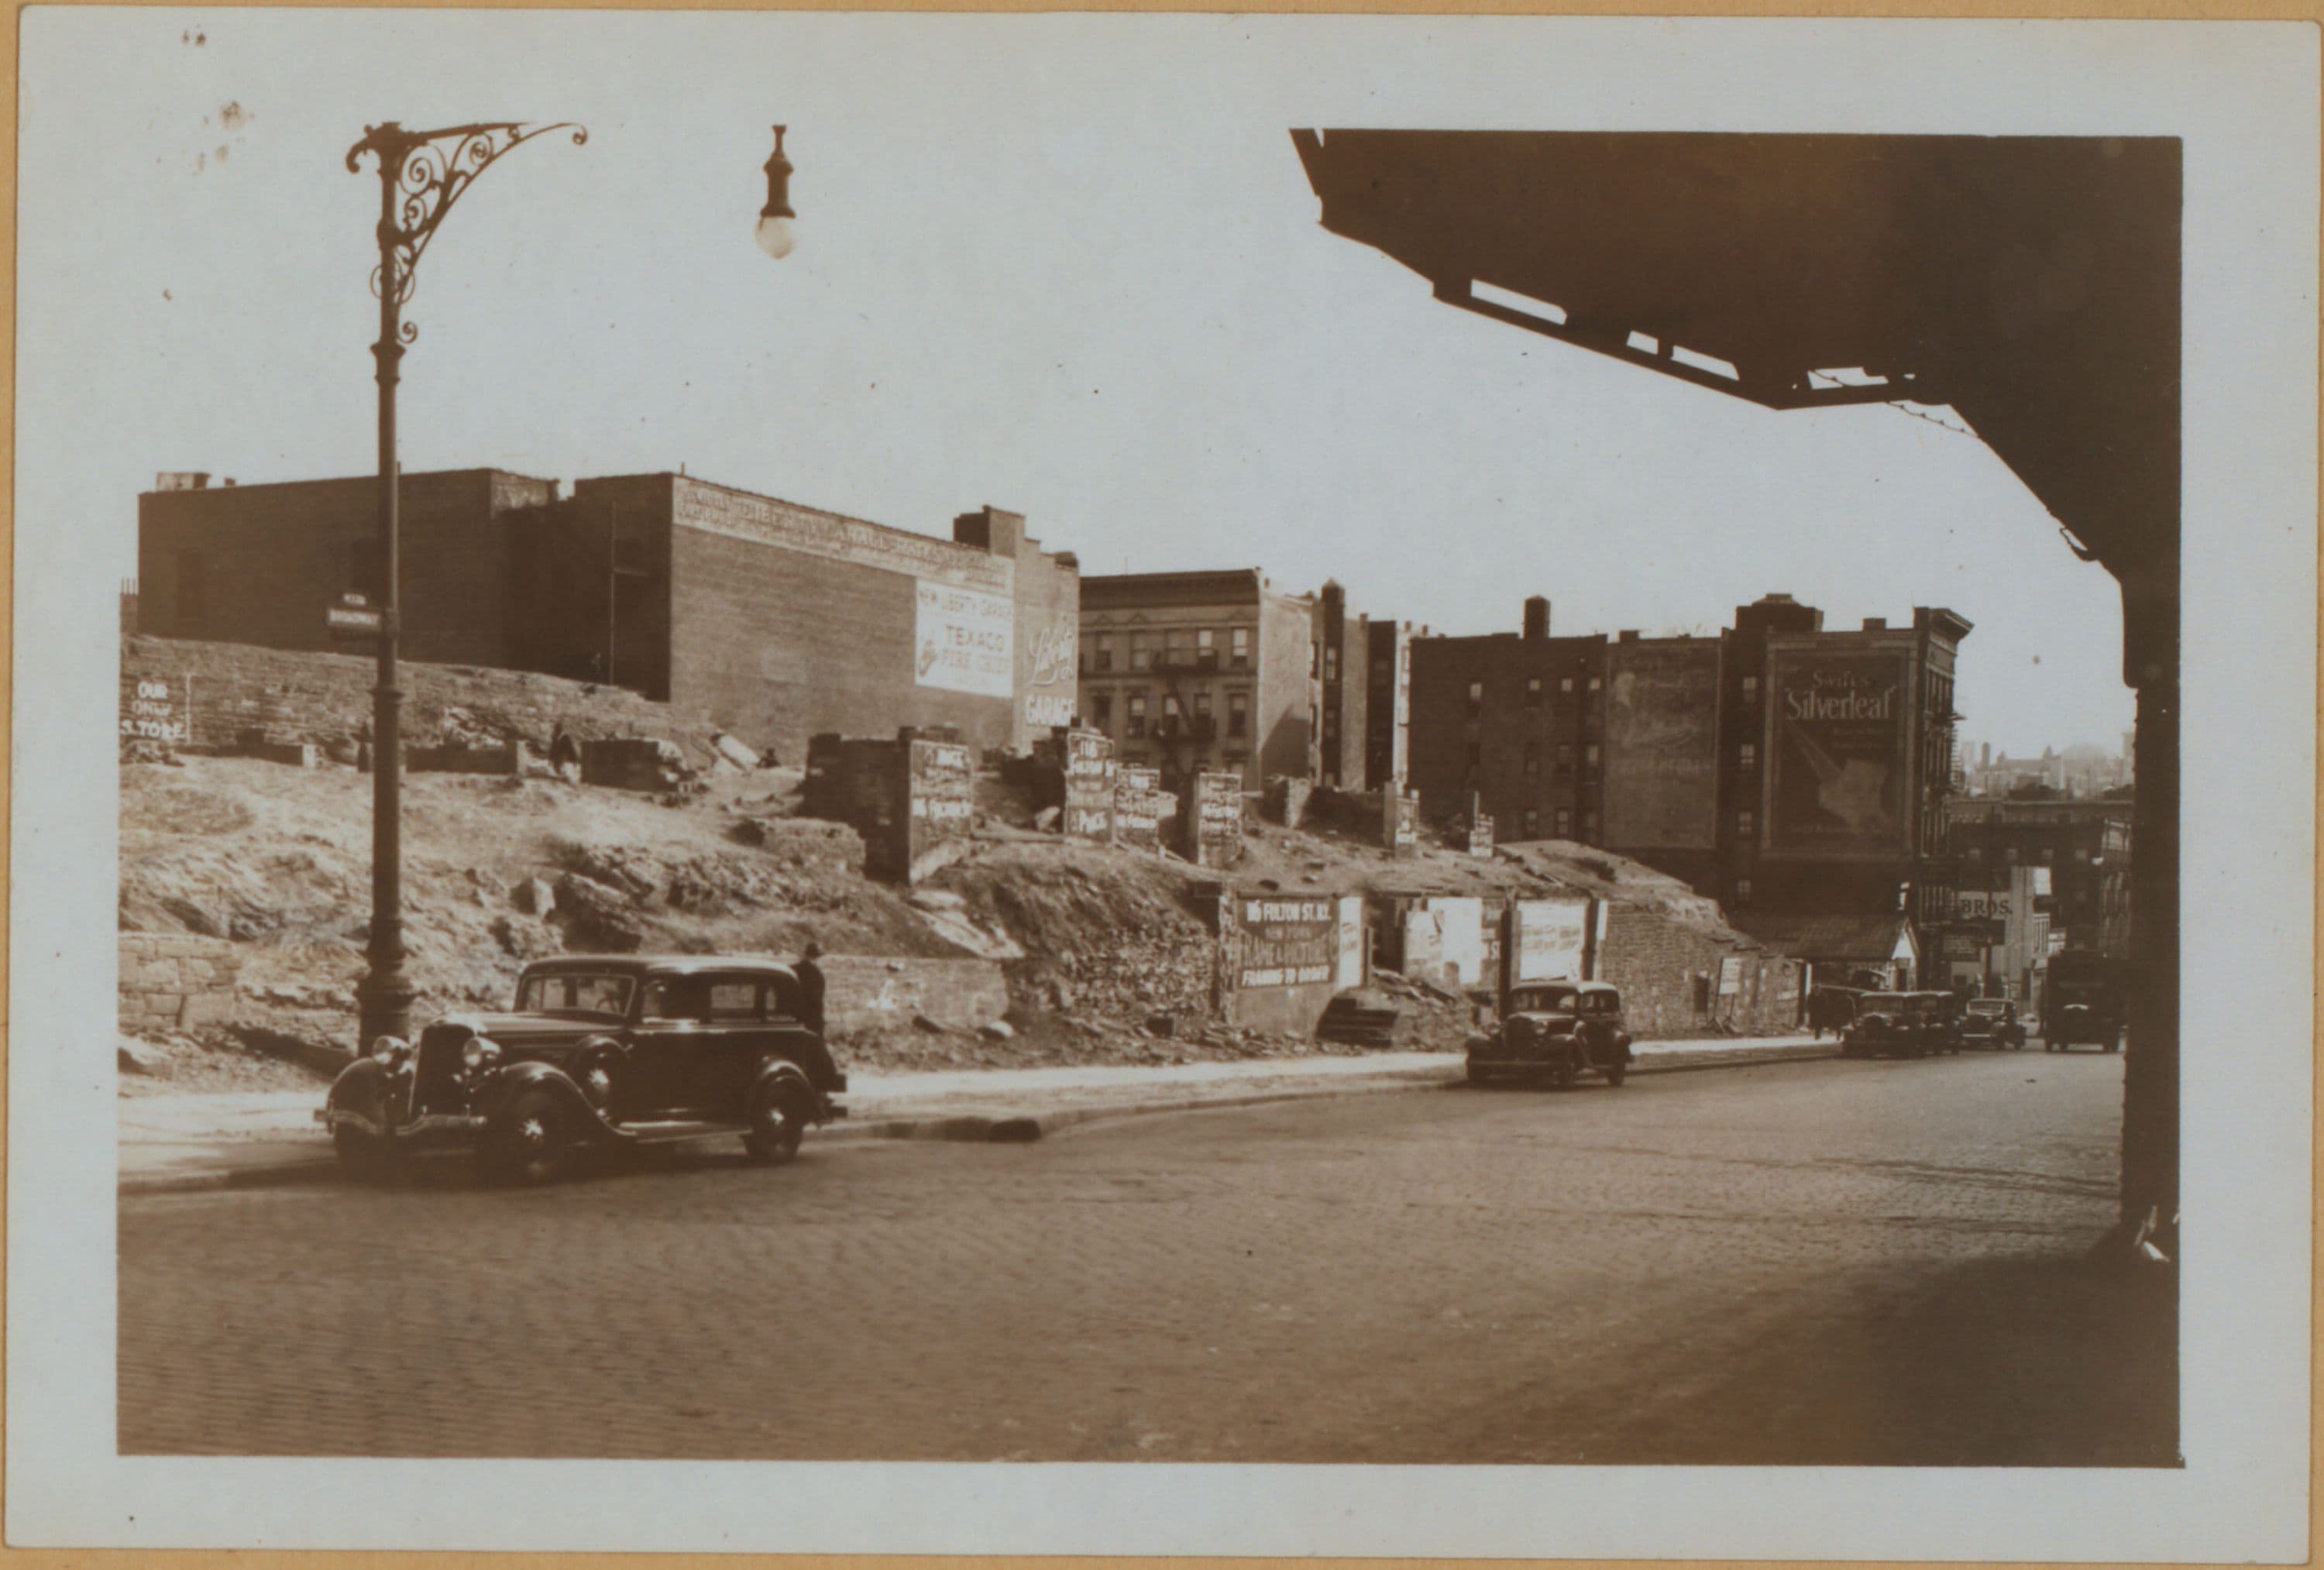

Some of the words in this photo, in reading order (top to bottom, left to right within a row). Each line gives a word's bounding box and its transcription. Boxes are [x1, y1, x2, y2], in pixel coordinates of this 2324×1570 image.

[945, 624, 1005, 653] TEXACO
[137, 680, 168, 699] OUR
[1026, 694, 1075, 727] GARAGE
[1263, 902, 1301, 922] FULTON
[1960, 898, 2013, 916] BROS.
